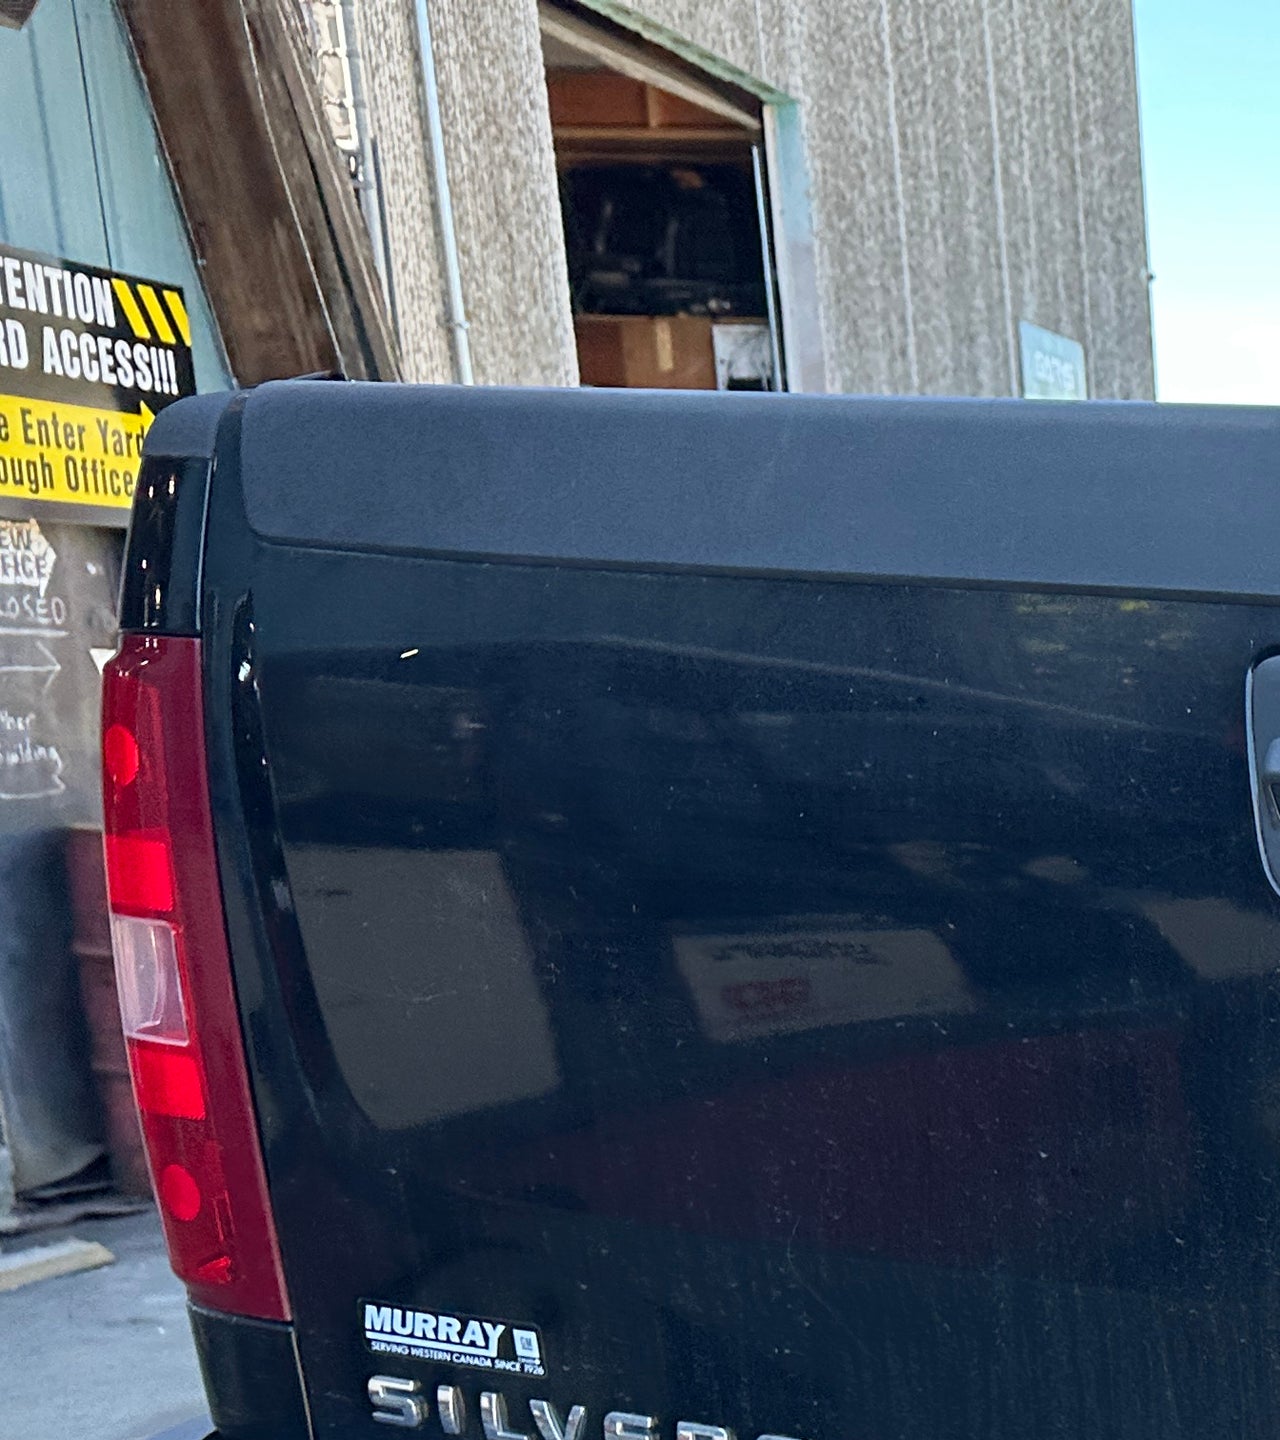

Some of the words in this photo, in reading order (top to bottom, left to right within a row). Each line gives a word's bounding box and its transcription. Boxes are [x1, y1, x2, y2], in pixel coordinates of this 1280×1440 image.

[0, 256, 116, 328] ENTION
[43, 326, 179, 396] ACCESS!!!
[20, 407, 86, 452] Enter
[65, 455, 133, 497] Office
[364, 1304, 506, 1357] MURRAY
[371, 1341, 409, 1355] SERVING
[410, 1348, 451, 1362] WESTERN
[452, 1353, 492, 1368] CANADA
[494, 1359, 521, 1372] SINCE
[523, 1363, 545, 1376] 1926
